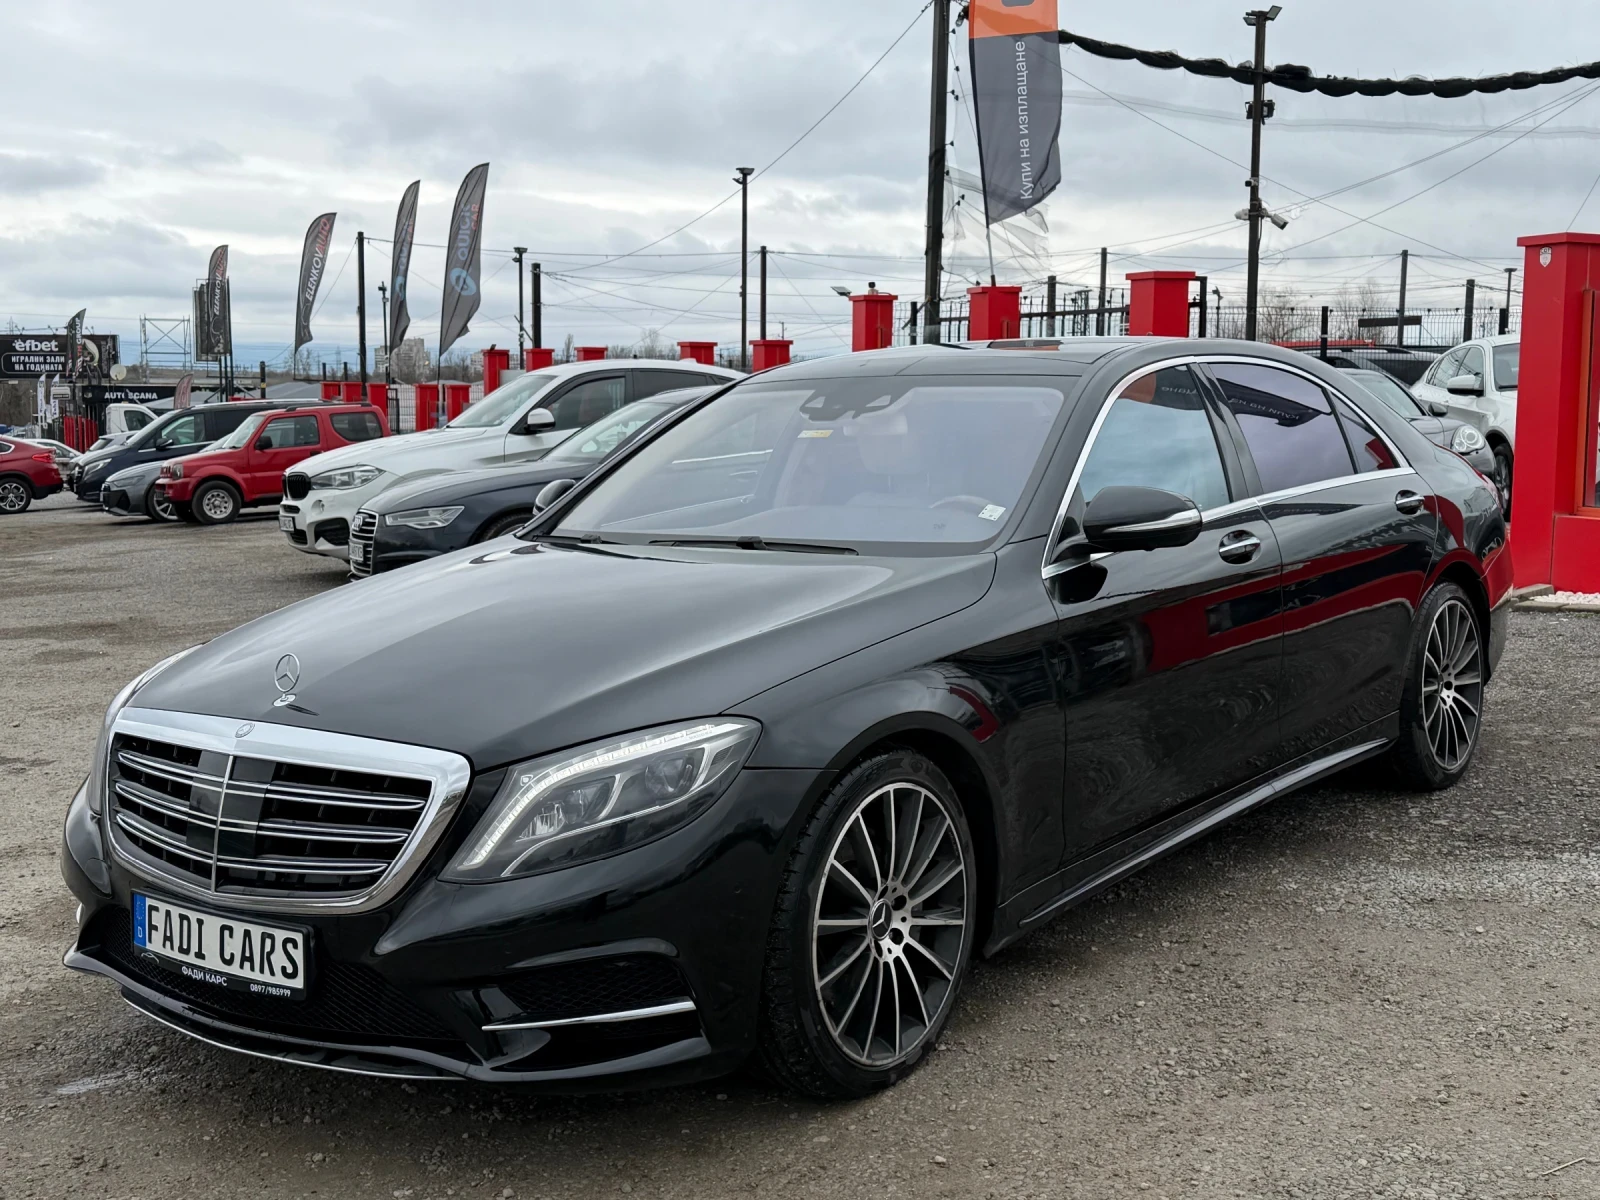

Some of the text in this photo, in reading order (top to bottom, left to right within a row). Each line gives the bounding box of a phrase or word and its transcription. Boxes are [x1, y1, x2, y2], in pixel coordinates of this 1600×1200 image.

[1015, 41, 1034, 199] Купи на изплащане
[15, 339, 59, 351] efbet
[11, 355, 65, 363] ИГРАЛНИ ЗАЛИ
[14, 363, 63, 372] НА ГОДИНАТА
[147, 904, 206, 960] FADI
[219, 924, 299, 979] CARS
[181, 966, 228, 986] ФАДИ КАРС
[250, 983, 291, 998] 0897/985999
